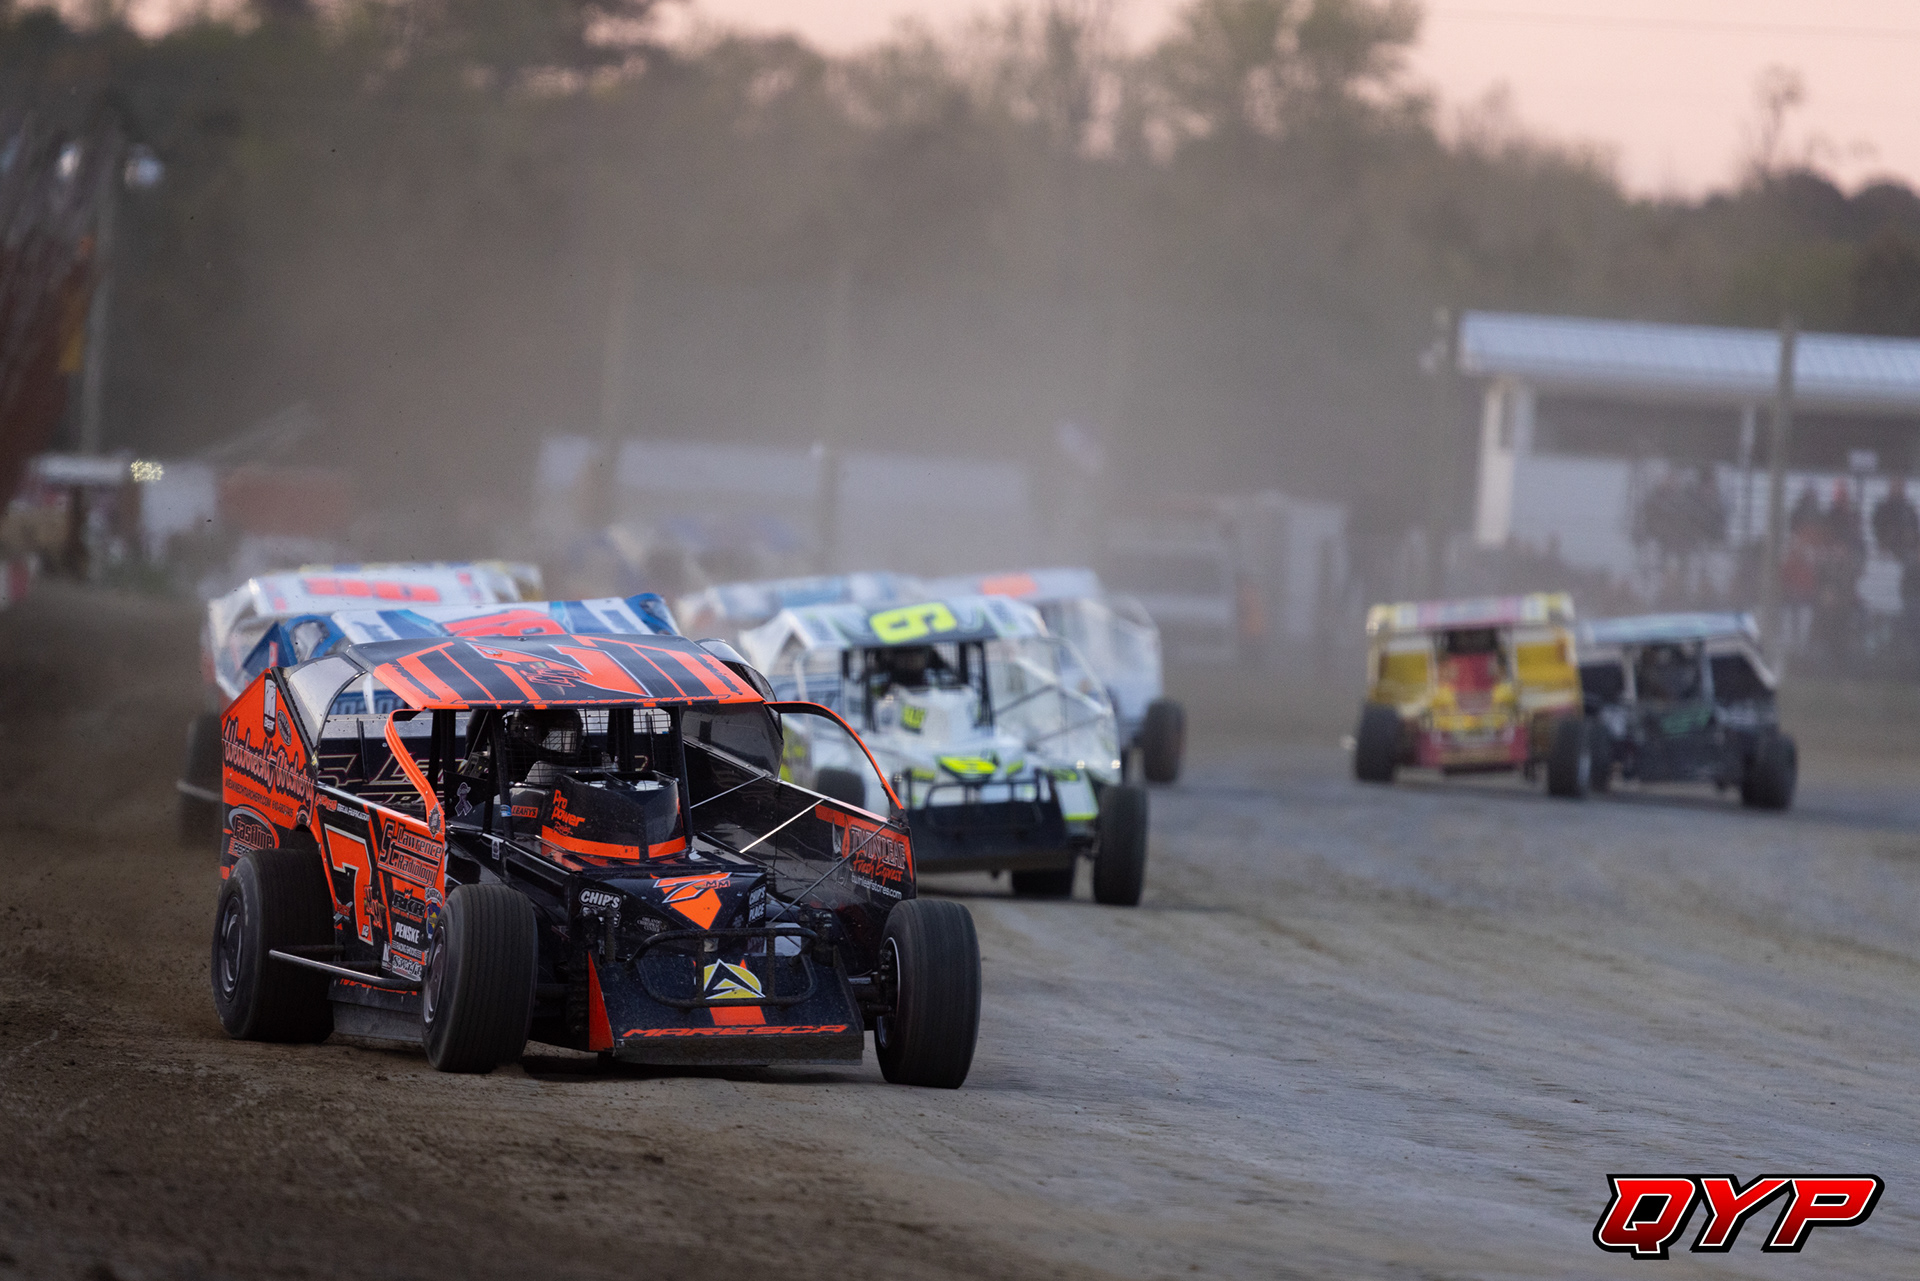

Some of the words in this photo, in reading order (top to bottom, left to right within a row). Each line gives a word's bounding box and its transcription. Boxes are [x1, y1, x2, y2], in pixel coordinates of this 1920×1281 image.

[553, 789, 568, 810] Pro
[551, 806, 586, 827] power
[397, 822, 443, 860] Lawrence
[851, 825, 905, 870] TWINLEAF
[397, 853, 437, 888] Radiology
[324, 823, 373, 946] 7
[580, 890, 621, 909] CHIP'S
[394, 921, 420, 944] PENSKE
[622, 1024, 849, 1037] MARESCA
